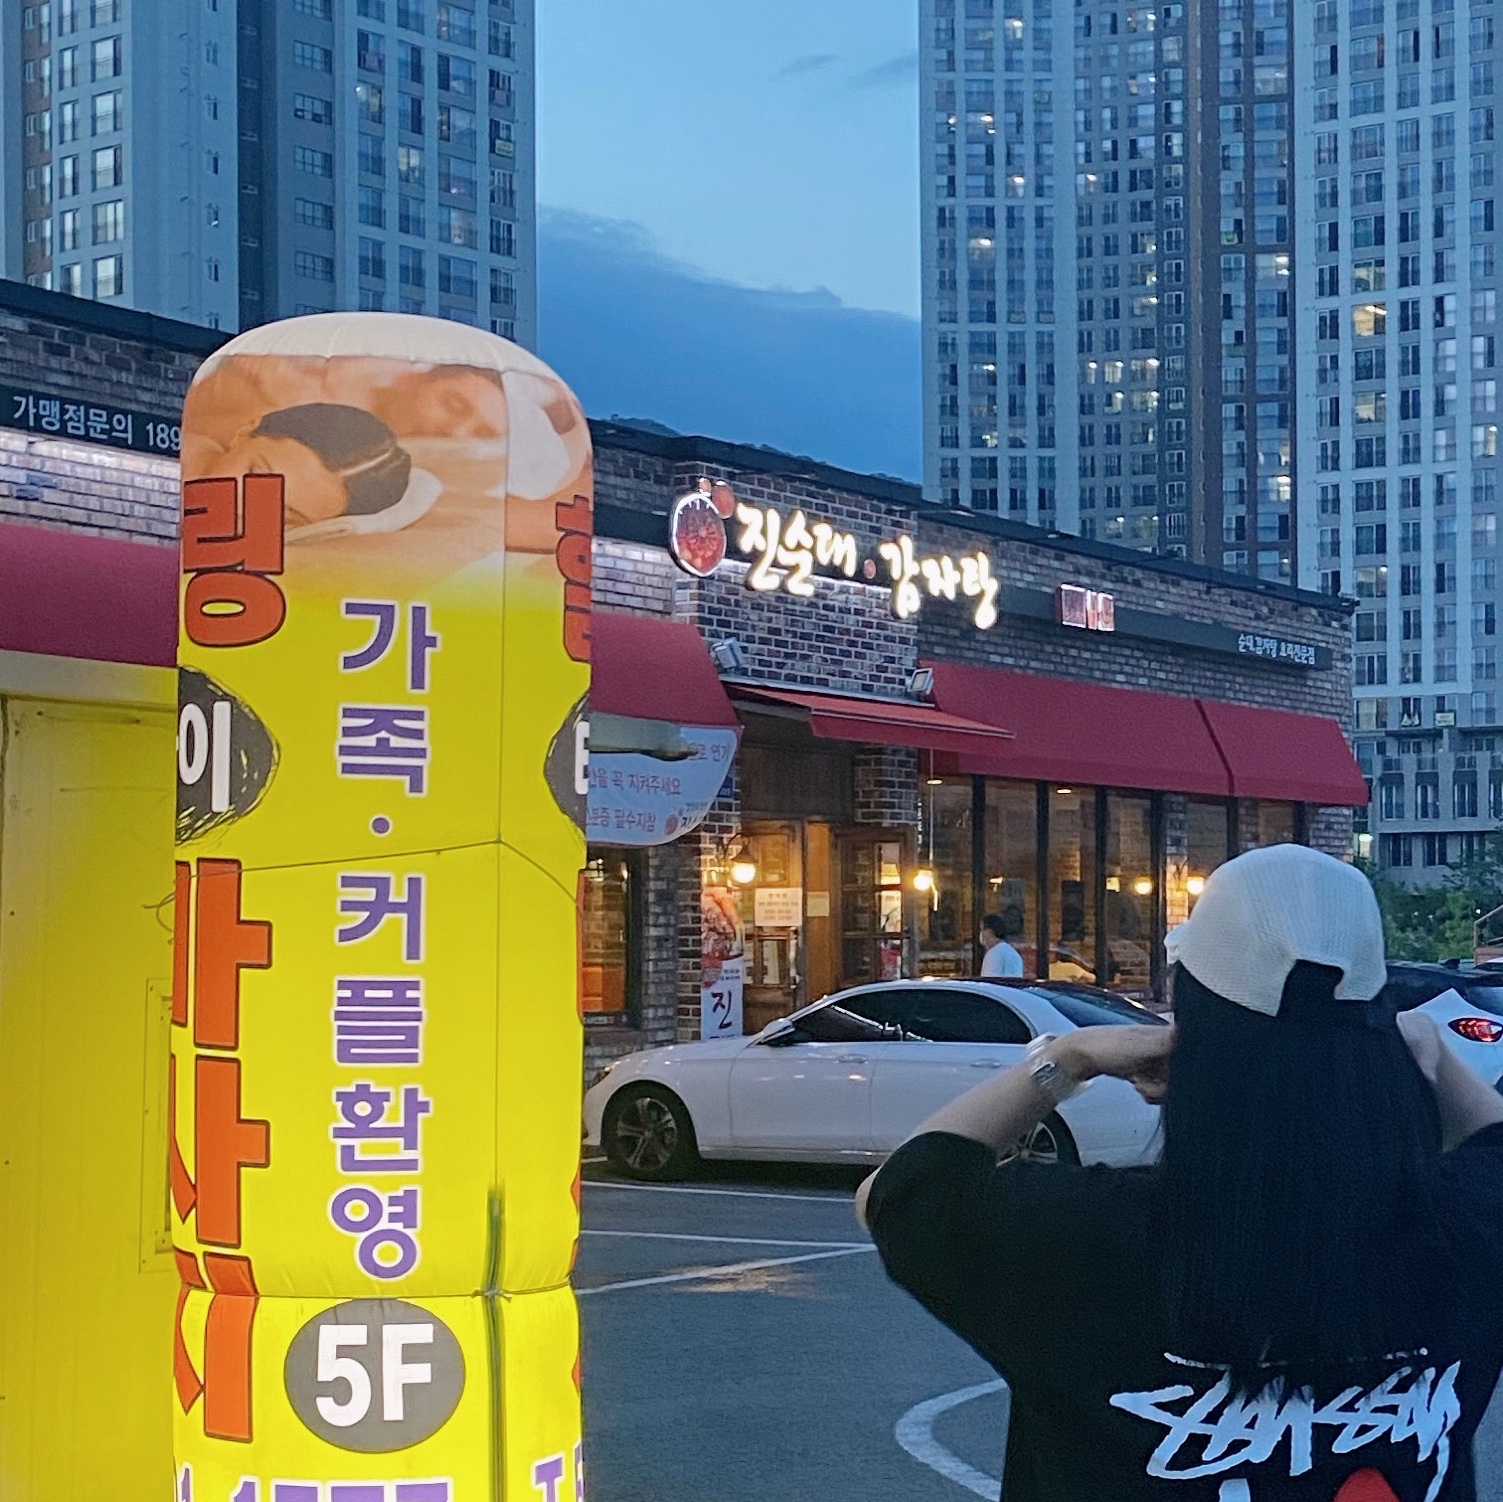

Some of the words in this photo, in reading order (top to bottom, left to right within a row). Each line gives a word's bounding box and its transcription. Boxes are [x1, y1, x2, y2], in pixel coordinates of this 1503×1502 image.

[13, 394, 133, 445] 가맹점문의
[736, 502, 857, 597] 진순대
[879, 534, 998, 630] 감자탕
[628, 773, 683, 796] 지켜주세요
[711, 990, 733, 1030] 진
[315, 1323, 434, 1427] 5F
